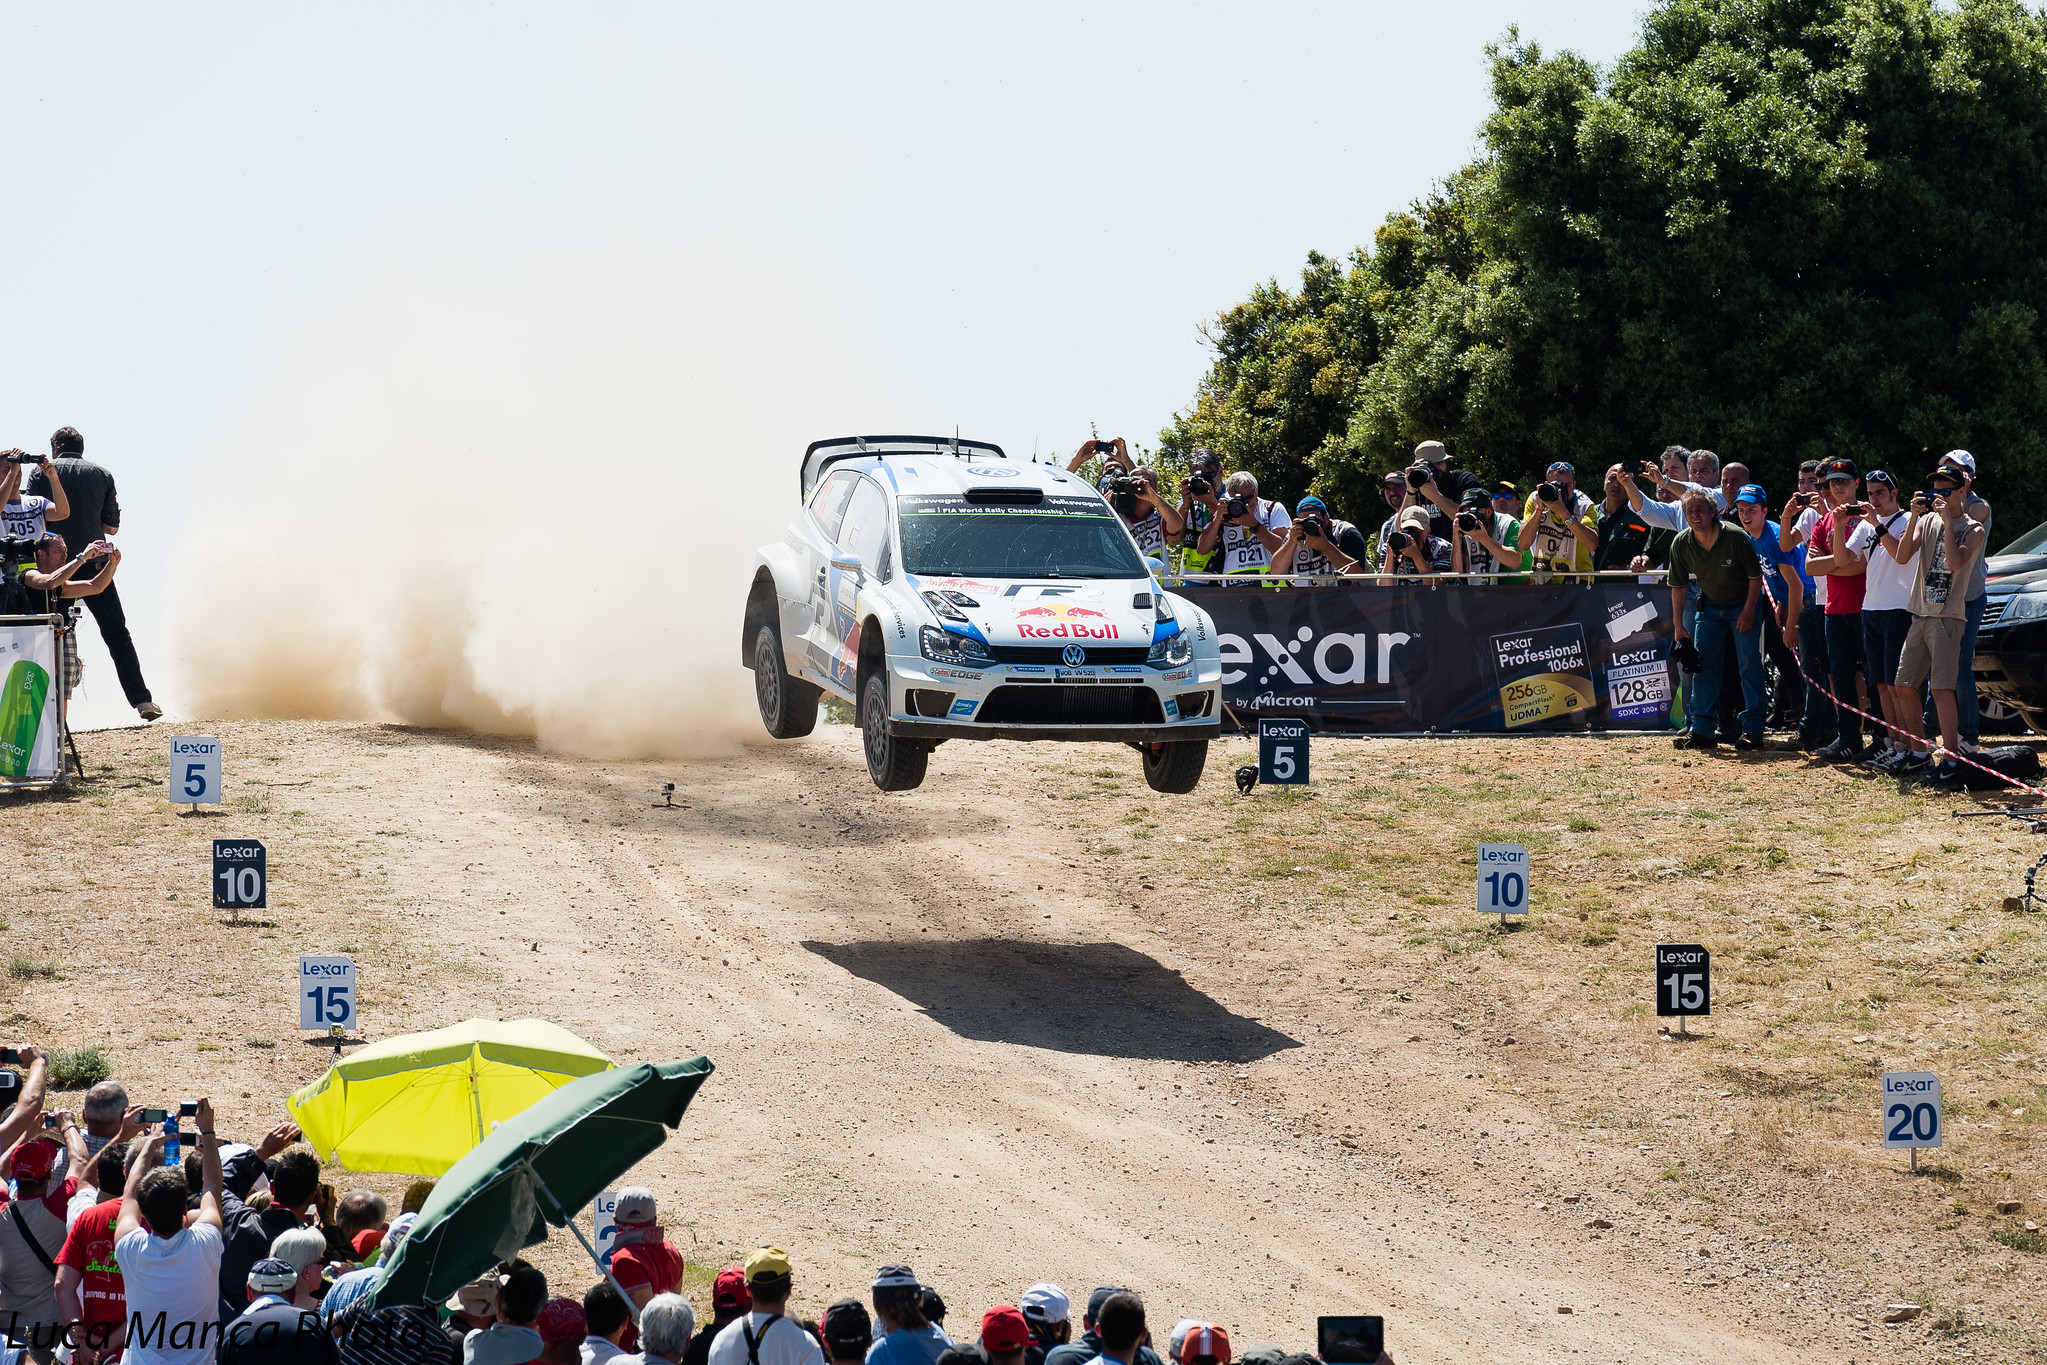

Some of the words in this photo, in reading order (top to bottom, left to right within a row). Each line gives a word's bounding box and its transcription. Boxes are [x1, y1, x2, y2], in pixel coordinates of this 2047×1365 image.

[1048, 499, 1105, 507] Volkswagen
[1238, 548, 1263, 563] 021
[1607, 601, 1624, 613] Lexar
[1611, 608, 1627, 620] 633x
[1016, 623, 1068, 638] Red
[1073, 624, 1120, 639] Bull
[1496, 638, 1533, 652] Lexar
[1217, 626, 1412, 685] exar
[1499, 640, 1581, 668] Professional
[1612, 649, 1657, 666] Lexar
[1547, 657, 1584, 672] 1066x
[1612, 664, 1655, 678] PLATINUM
[950, 670, 984, 680] EDGE
[1236, 698, 1248, 708] by
[1250, 691, 1314, 710] Micron
[1510, 707, 1542, 722] UDMA
[1544, 705, 1550, 714] 7
[1618, 708, 1640, 718] SDXC
[1642, 706, 1658, 714] 200x
[1263, 724, 1304, 737] Lexar
[0, 737, 26, 757] exar
[174, 741, 216, 754] Lexar
[11, 759, 20, 767] 3.0
[1273, 746, 1295, 779] 5
[183, 764, 206, 797] 5
[216, 844, 260, 859] Lexar
[1481, 848, 1524, 863] Lexar
[219, 867, 261, 903] 10
[1484, 871, 1524, 908] 10
[1660, 950, 1704, 964] Lexar
[303, 961, 350, 976] Lexar
[1663, 973, 1704, 1010] 15
[307, 986, 350, 1023] 15
[1886, 1078, 1934, 1092] Lexar
[1888, 1102, 1938, 1141] 20
[598, 1198, 615, 1213] Le
[86, 1261, 122, 1274] Sard
